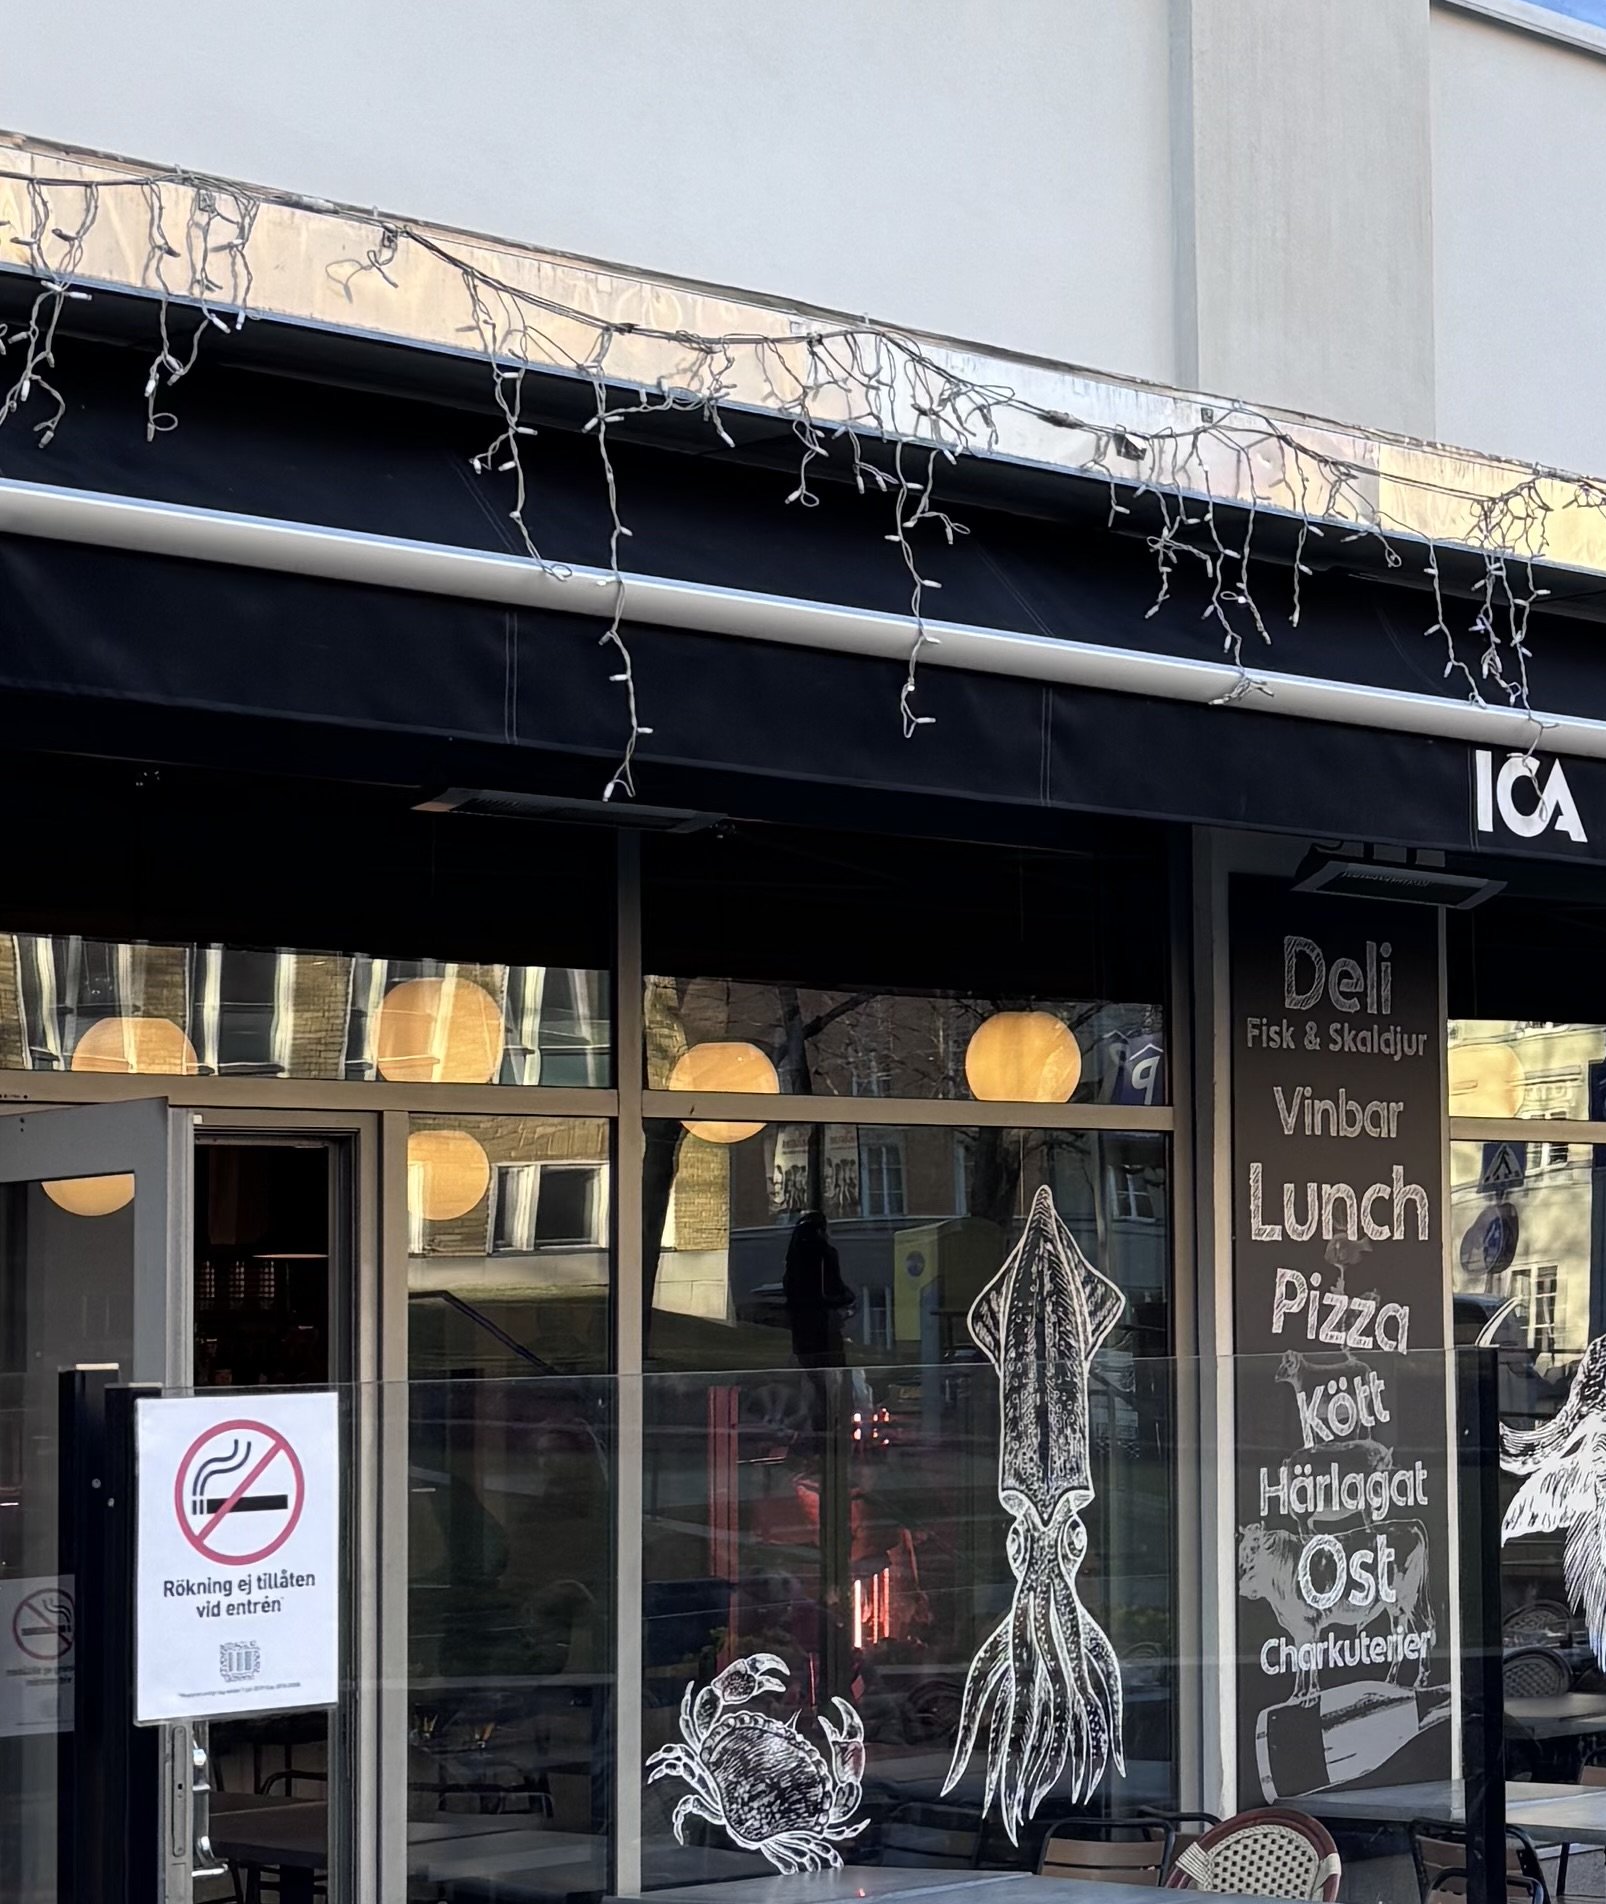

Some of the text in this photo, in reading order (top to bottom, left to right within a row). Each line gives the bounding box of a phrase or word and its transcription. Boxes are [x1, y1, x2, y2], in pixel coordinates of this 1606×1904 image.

[1475, 749, 1588, 843] ICA
[1283, 935, 1393, 1015] Deli
[1247, 1017, 1428, 1062] Fisk & Skaldjur
[1273, 1086, 1404, 1138] Vinbar
[1249, 1162, 1429, 1241] Lunch
[1271, 1267, 1410, 1355] Pizza
[1296, 1371, 1391, 1450] Kött
[1259, 1460, 1428, 1520] Härlagat
[163, 1568, 316, 1597] Rökning ej tillåten
[1298, 1533, 1397, 1610] Ost
[196, 1600, 221, 1618] vid
[1259, 1626, 1431, 1677] Charkuterier
